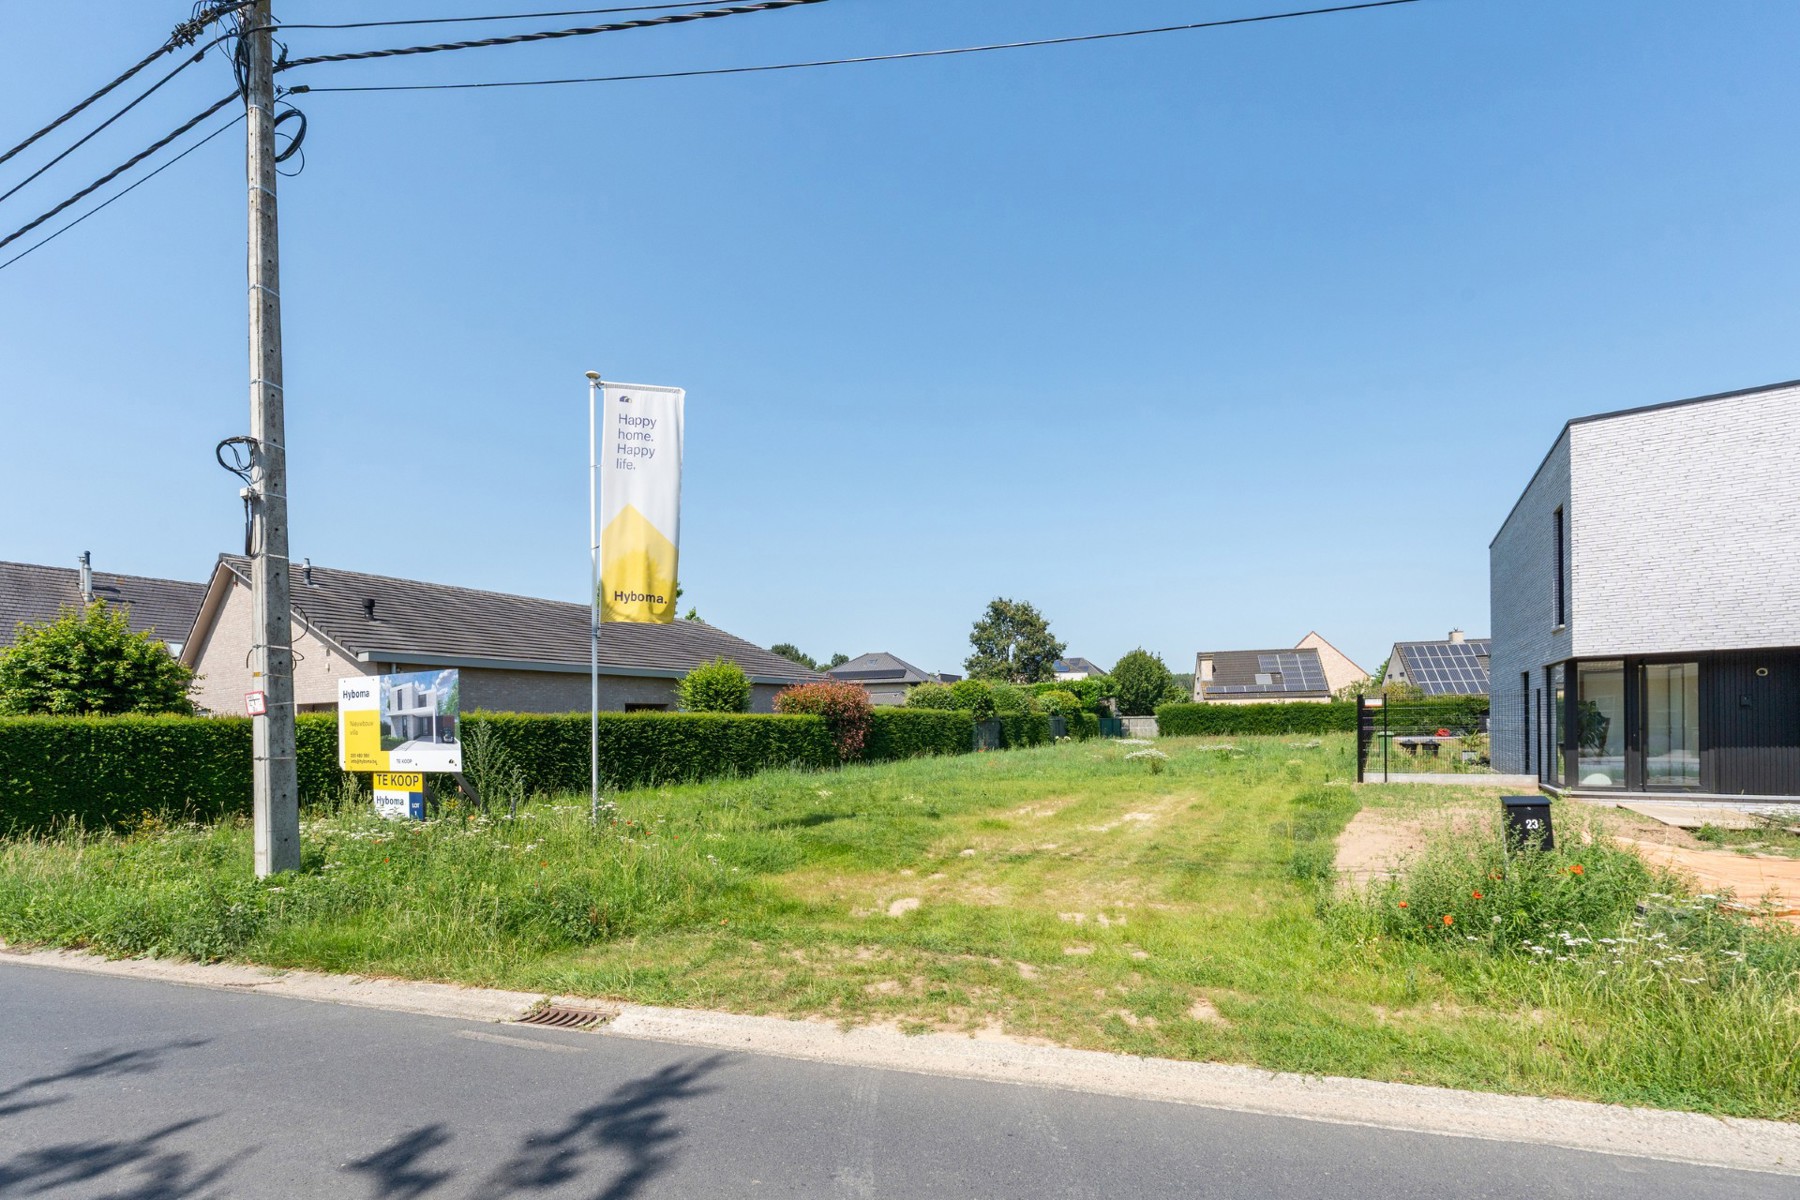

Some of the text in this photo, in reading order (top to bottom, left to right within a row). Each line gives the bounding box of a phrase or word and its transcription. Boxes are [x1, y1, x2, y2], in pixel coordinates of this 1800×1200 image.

[618, 413, 657, 430] Happy
[618, 428, 654, 442] home.
[617, 443, 656, 459] Happy
[616, 458, 636, 470] life.
[614, 590, 668, 605] Hyboma.
[342, 689, 370, 701] Hyboma
[376, 773, 419, 787] TE KOOP
[376, 795, 404, 807] Hyboma
[1525, 818, 1539, 830] 23
